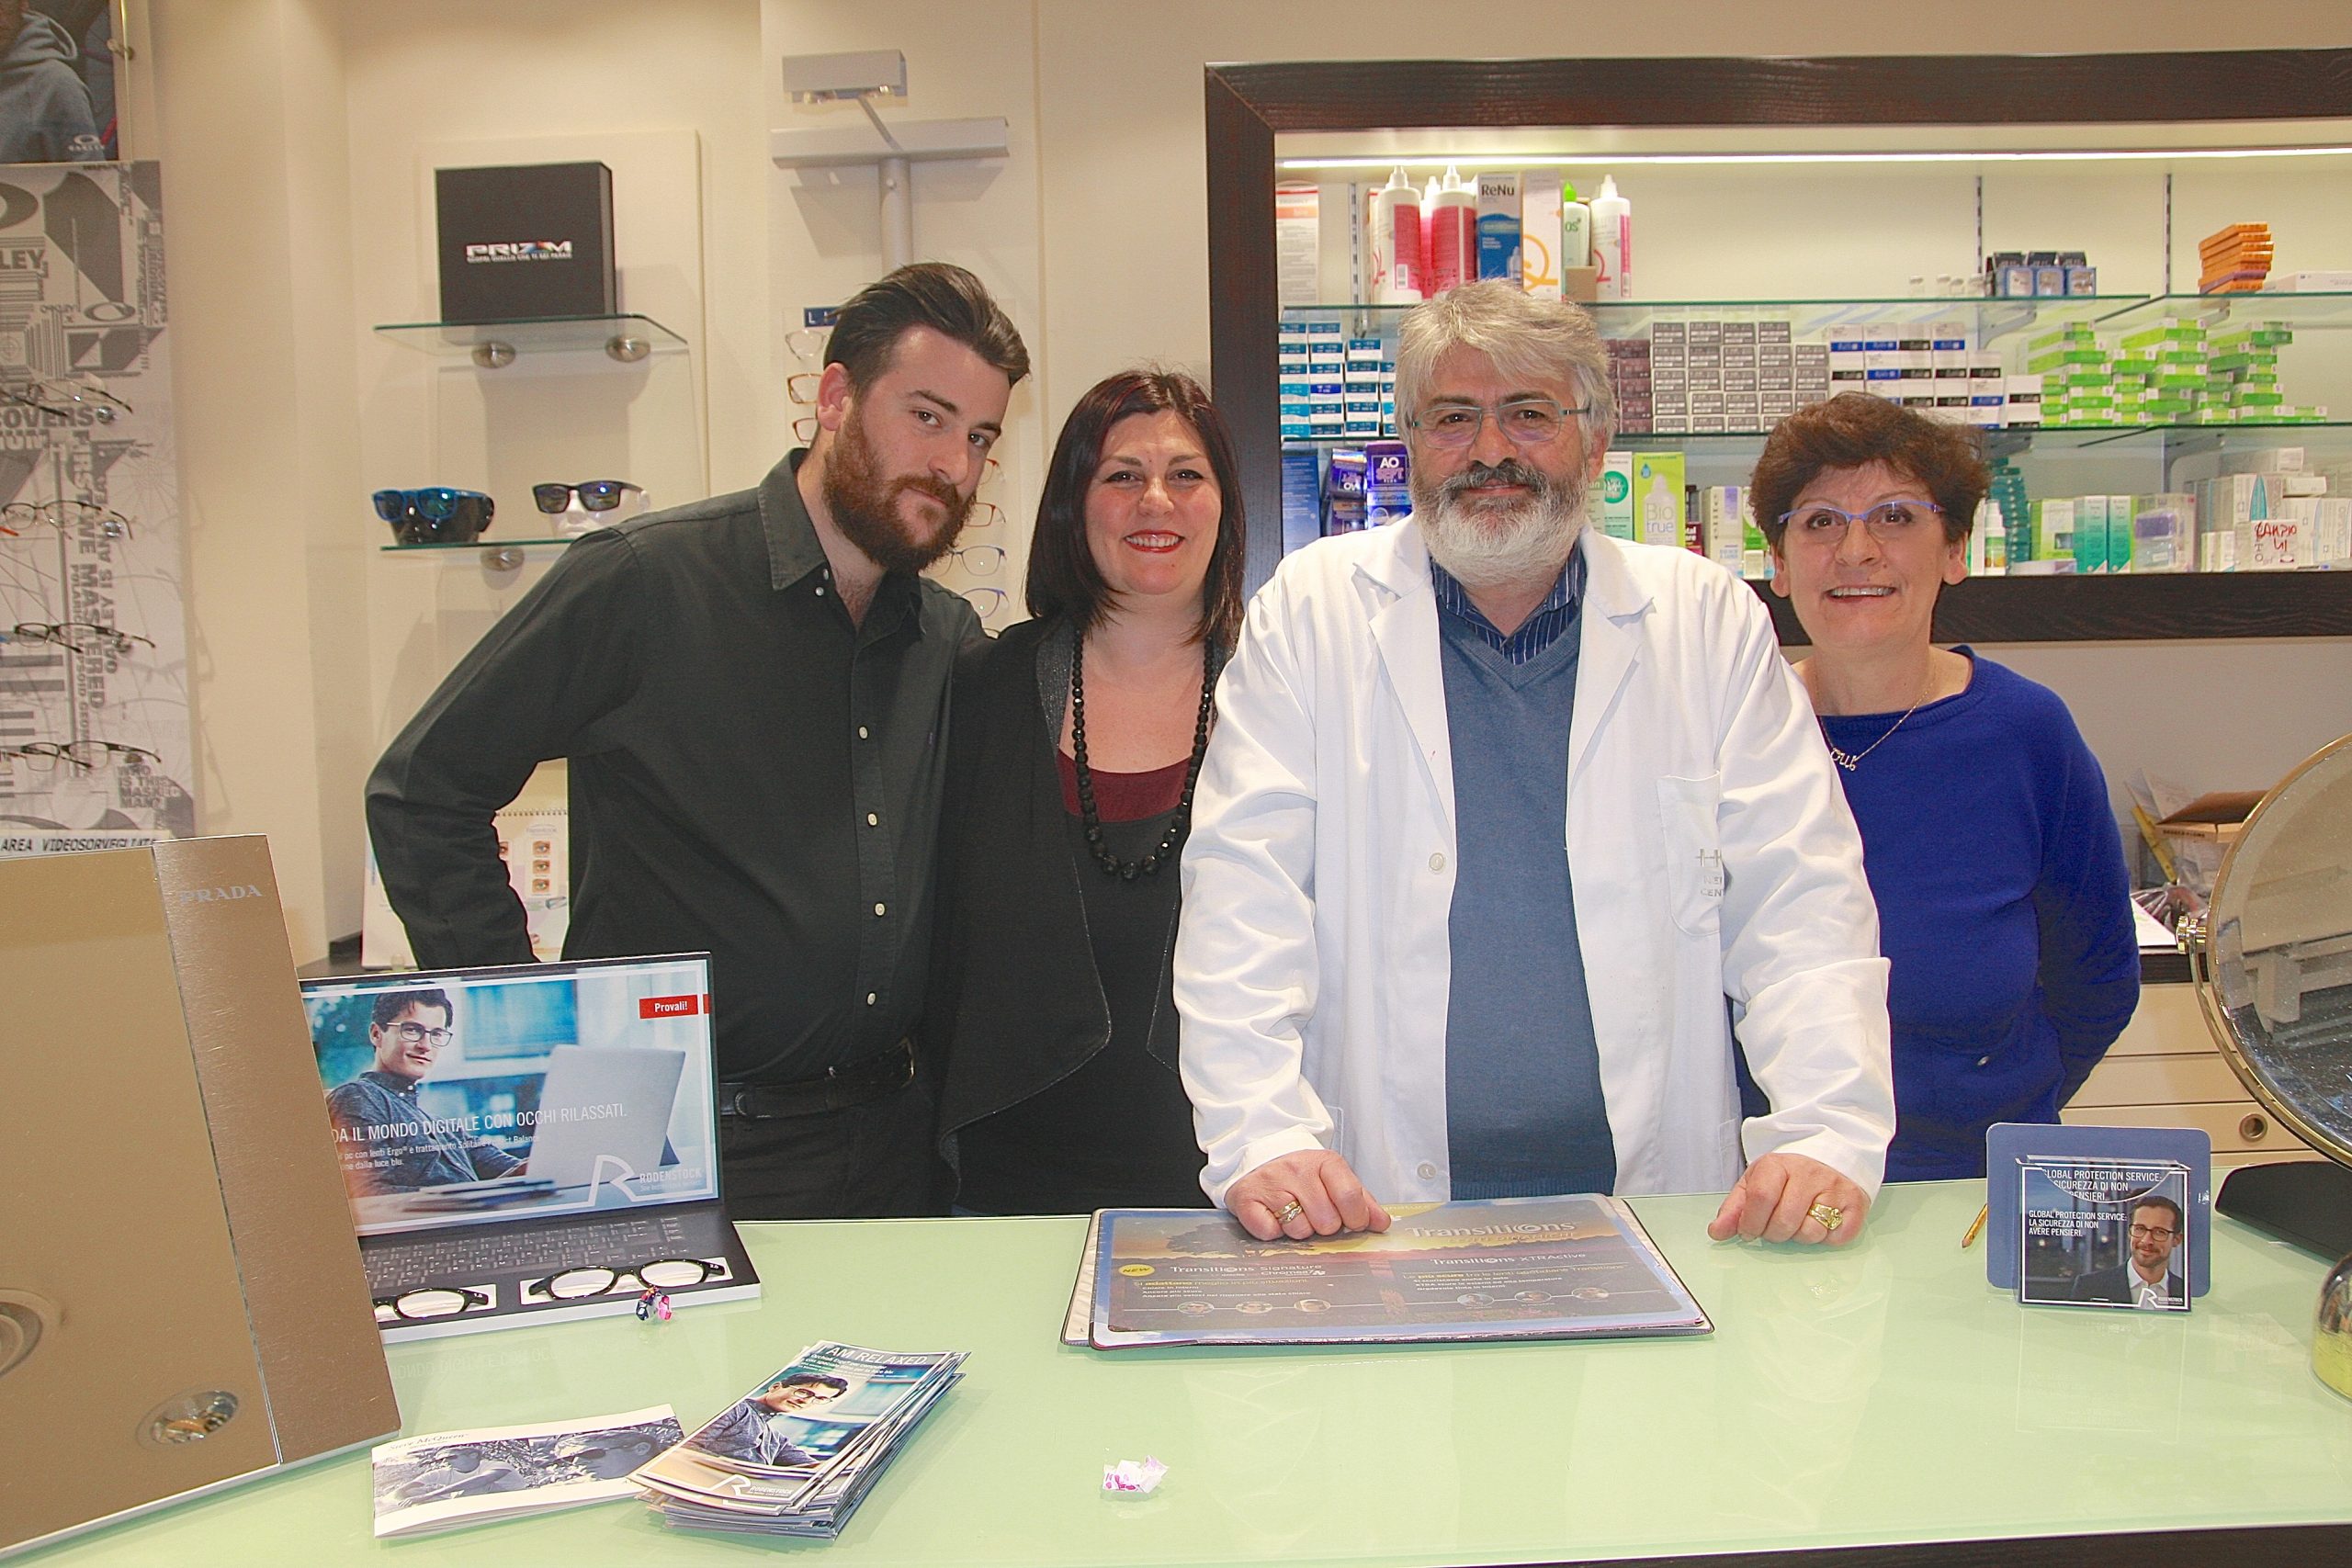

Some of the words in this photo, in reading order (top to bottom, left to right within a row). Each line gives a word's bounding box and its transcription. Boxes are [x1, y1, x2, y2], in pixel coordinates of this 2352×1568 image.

[1481, 184, 1515, 197] ReNu
[466, 241, 571, 256] PRIZM
[0, 406, 94, 427] OVERS
[1380, 457, 1400, 468] AO
[1646, 521, 1674, 533] true
[2, 838, 32, 852] AREA
[42, 837, 156, 852] VIDEOSORVEGLIAT
[181, 884, 263, 905] PRADA
[654, 1000, 688, 1012] Provali!
[353, 1126, 365, 1142] IL
[368, 1121, 418, 1140] MONDO
[424, 1115, 481, 1134] DIGITALE
[484, 1111, 512, 1129] CON
[516, 1107, 556, 1126] OCCHI
[560, 1102, 628, 1122] RILASSATI.
[2074, 1170, 2124, 1180] PROTECTION
[2053, 1179, 2098, 1190] SICUREZZA
[2100, 1181, 2109, 1190] DI
[2110, 1181, 2129, 1191] NON
[2029, 1210, 2056, 1219] GLOBAL
[2056, 1211, 2097, 1220] PROTECTION
[2097, 1213, 2128, 1222] SERVICE:
[1405, 1221, 1577, 1237] Transitions
[2029, 1219, 2037, 1227] LA
[2039, 1220, 2075, 1228] SICUREZZA
[2029, 1227, 2050, 1235] AVERE
[1430, 1256, 1515, 1265] Transitions
[1170, 1266, 1255, 1274] Transitions
[826, 1346, 855, 1359] AM
[854, 1350, 927, 1366] RELAXED.
